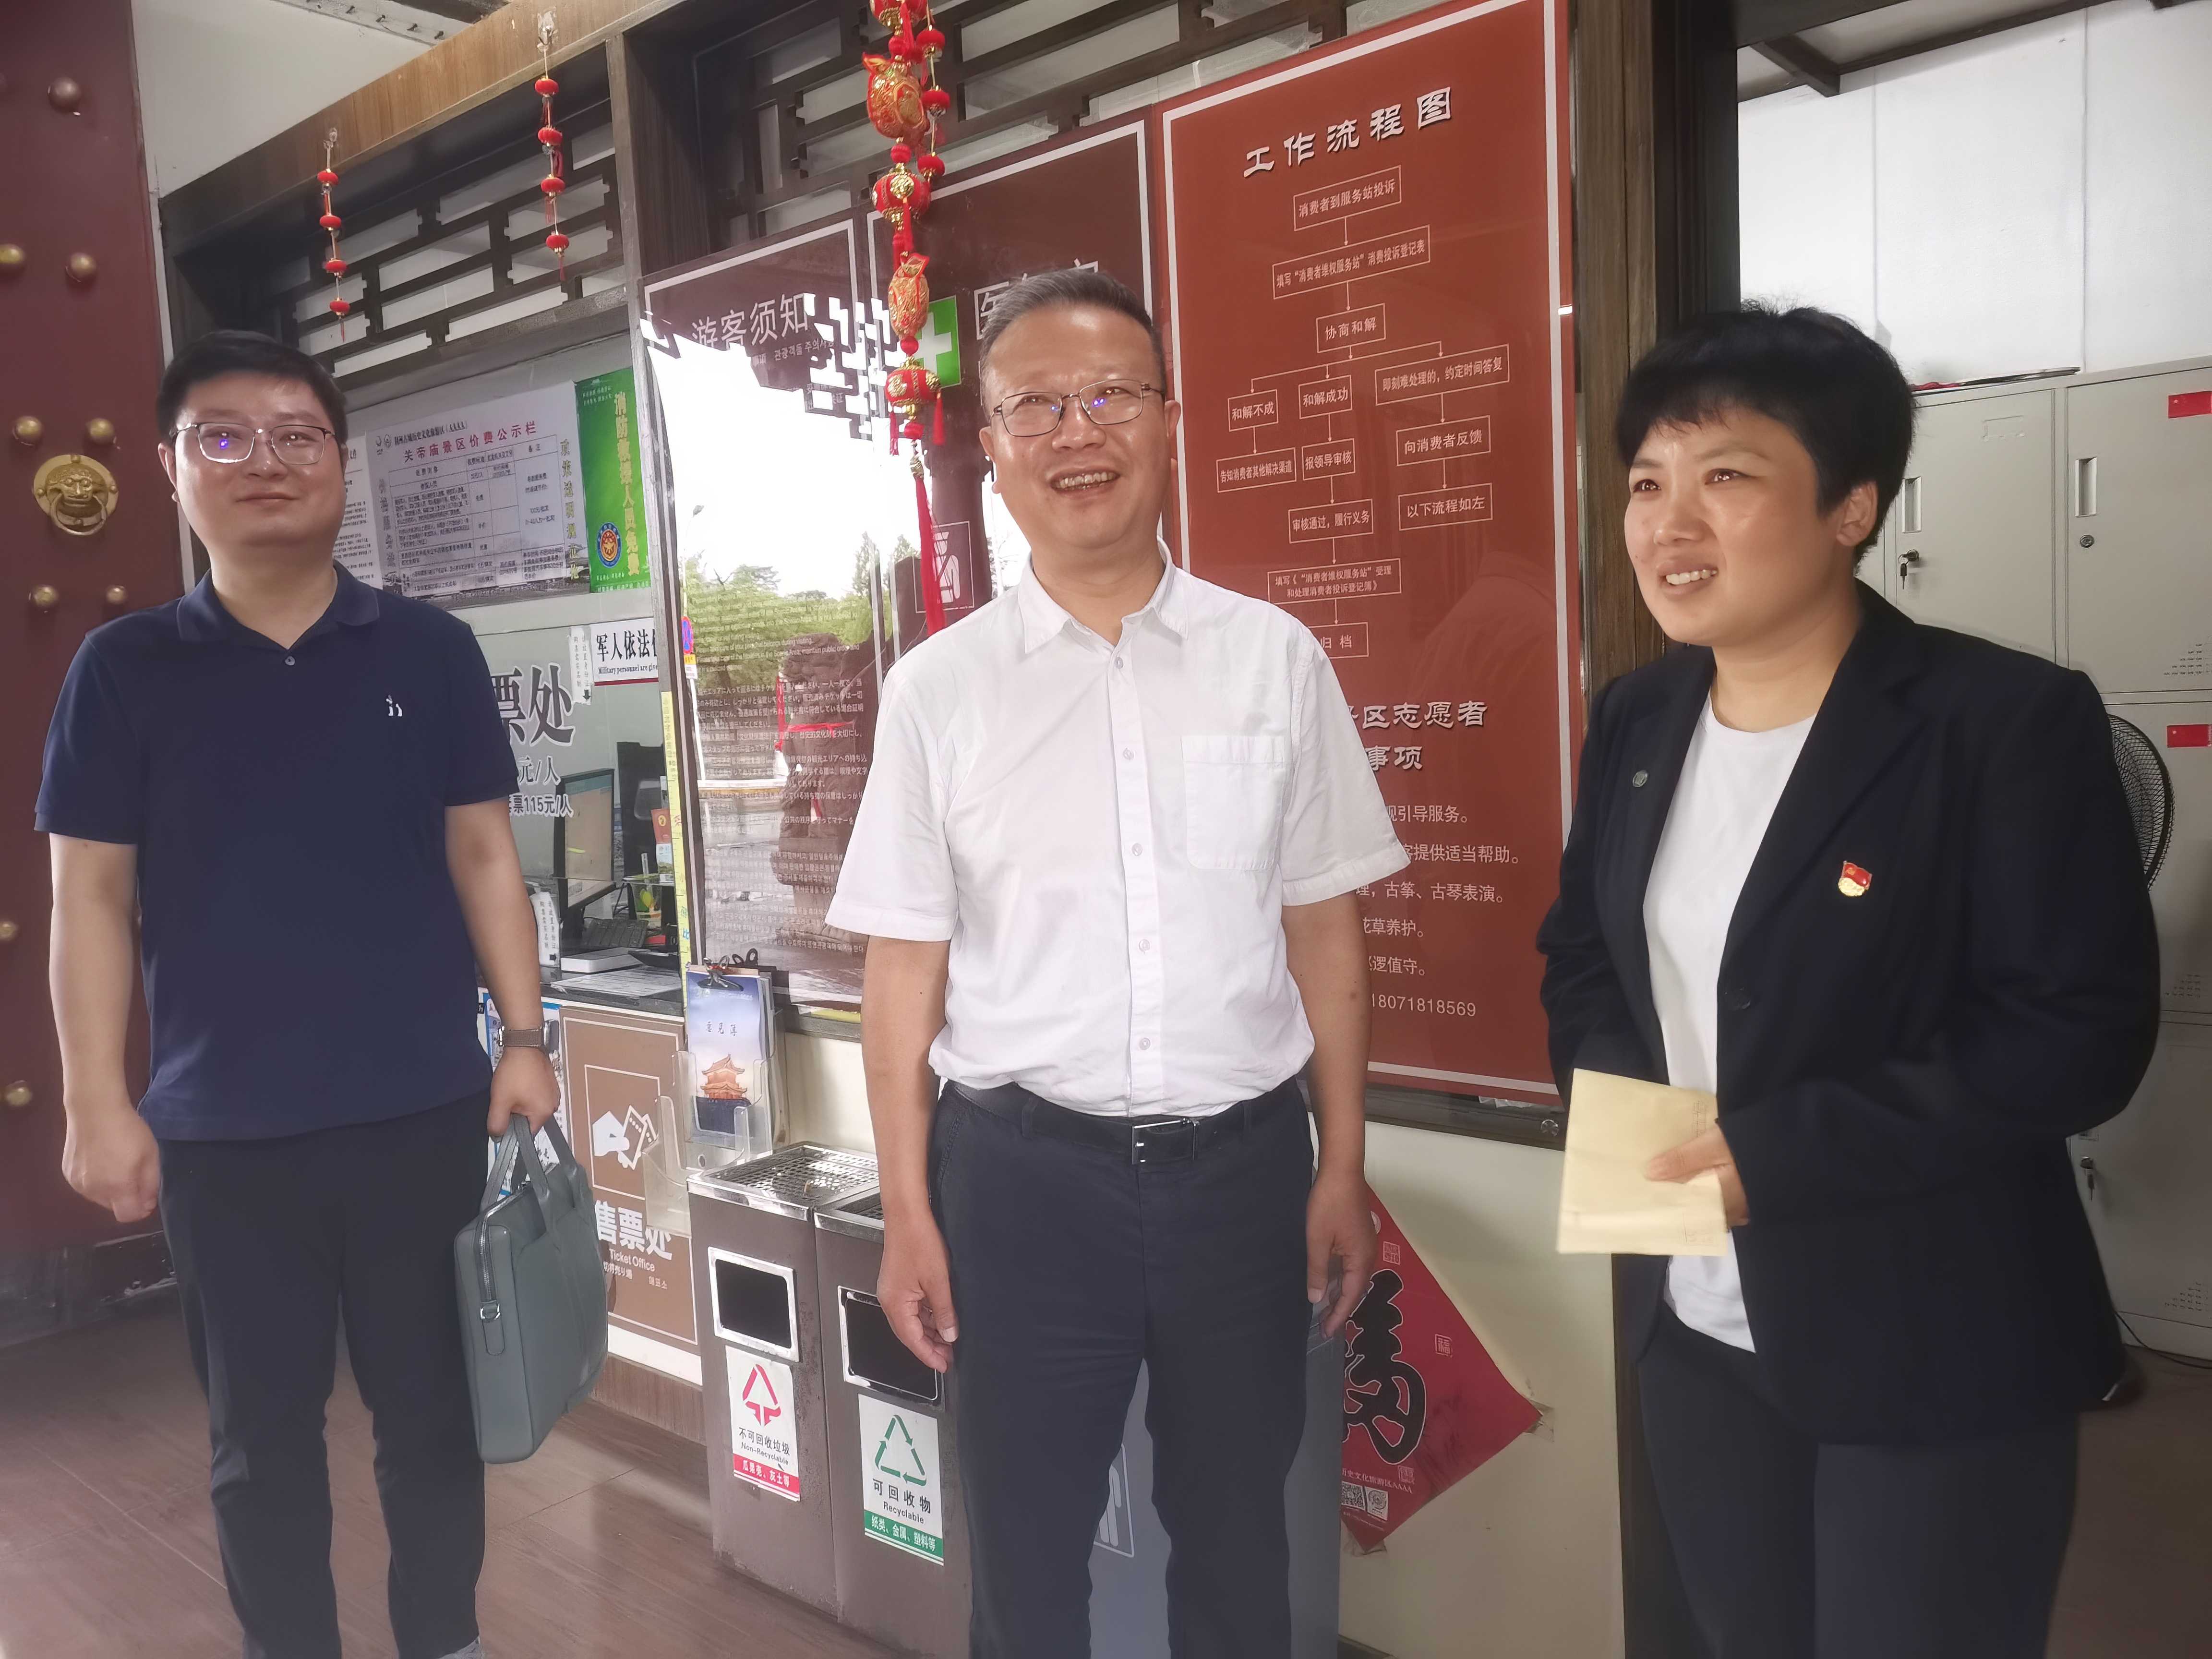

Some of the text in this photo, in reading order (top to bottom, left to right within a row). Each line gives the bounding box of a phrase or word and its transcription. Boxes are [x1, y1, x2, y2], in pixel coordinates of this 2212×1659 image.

[1243, 86, 1452, 178] 工作流程图
[1298, 179, 1396, 219] 消费者到服务站投诉
[692, 294, 808, 350] 游客须知
[1324, 316, 1377, 340] 协商和解
[1302, 387, 1348, 408] 和解成功
[1231, 401, 1275, 421] 和解不成
[1404, 429, 1483, 455] 向消费者反馈
[1220, 459, 1292, 483] 告知消费者其他解决渠道
[1304, 450, 1352, 470] 报领导审核
[1407, 495, 1485, 518] 以下流程如左
[1292, 510, 1370, 532] 审核通过，履行义务
[509, 793, 574, 817] 票115元/人
[1371, 993, 1476, 1017] 18071818569
[595, 1200, 673, 1261] 售票处
[609, 1248, 655, 1272] Ticket Office
[739, 1427, 790, 1456] 不可回收垃圾
[741, 1442, 789, 1466] Non-Recyclable
[873, 1478, 931, 1514] 可回收物
[883, 1501, 925, 1524] Recyclable
[871, 1514, 936, 1552] 纸类、金属、塑料等
